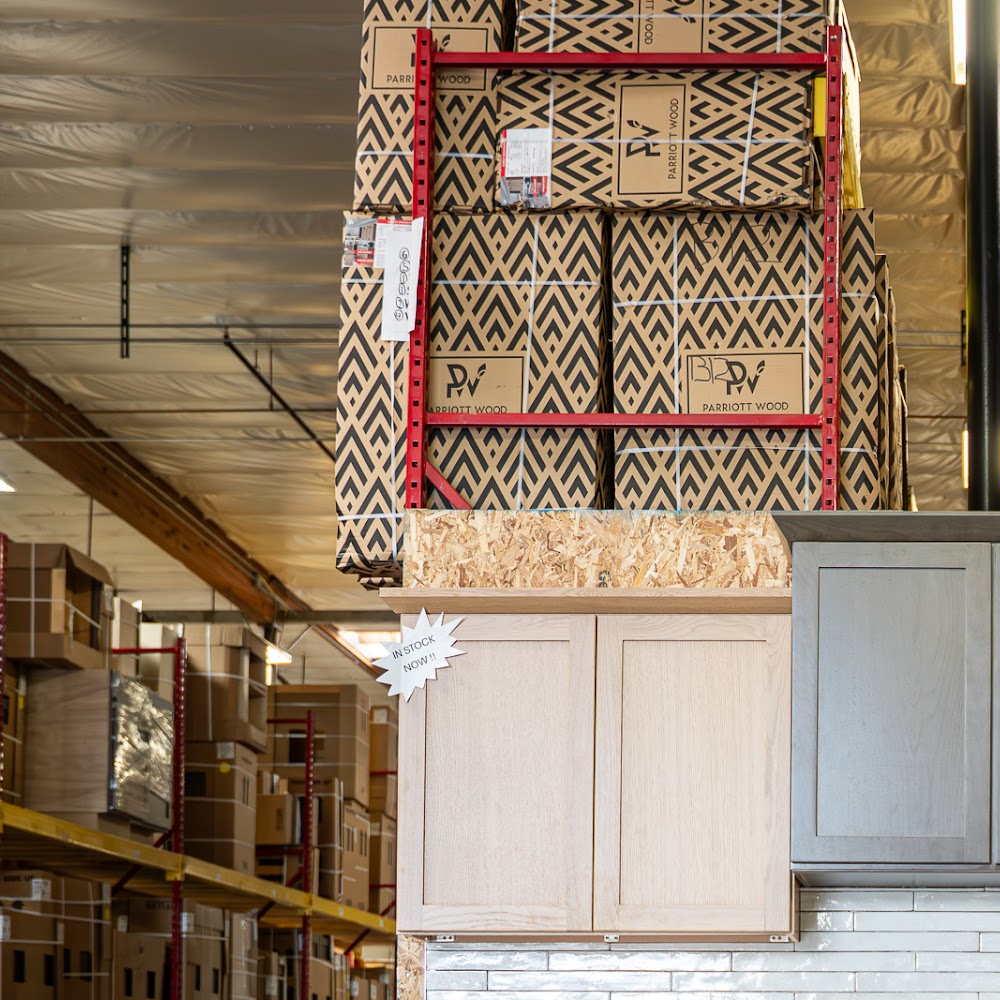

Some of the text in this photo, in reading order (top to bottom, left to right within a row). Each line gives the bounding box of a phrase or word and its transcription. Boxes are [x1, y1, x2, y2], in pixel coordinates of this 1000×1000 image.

[386, 74, 471, 84] PARRI WOOD
[669, 98, 679, 130] WOOD
[429, 405, 508, 414] ARRIOTT WOOD
[702, 402, 789, 412] PARRIOTT WOOD
[392, 634, 436, 660] IN STOCK
[403, 655, 428, 673] NOW
